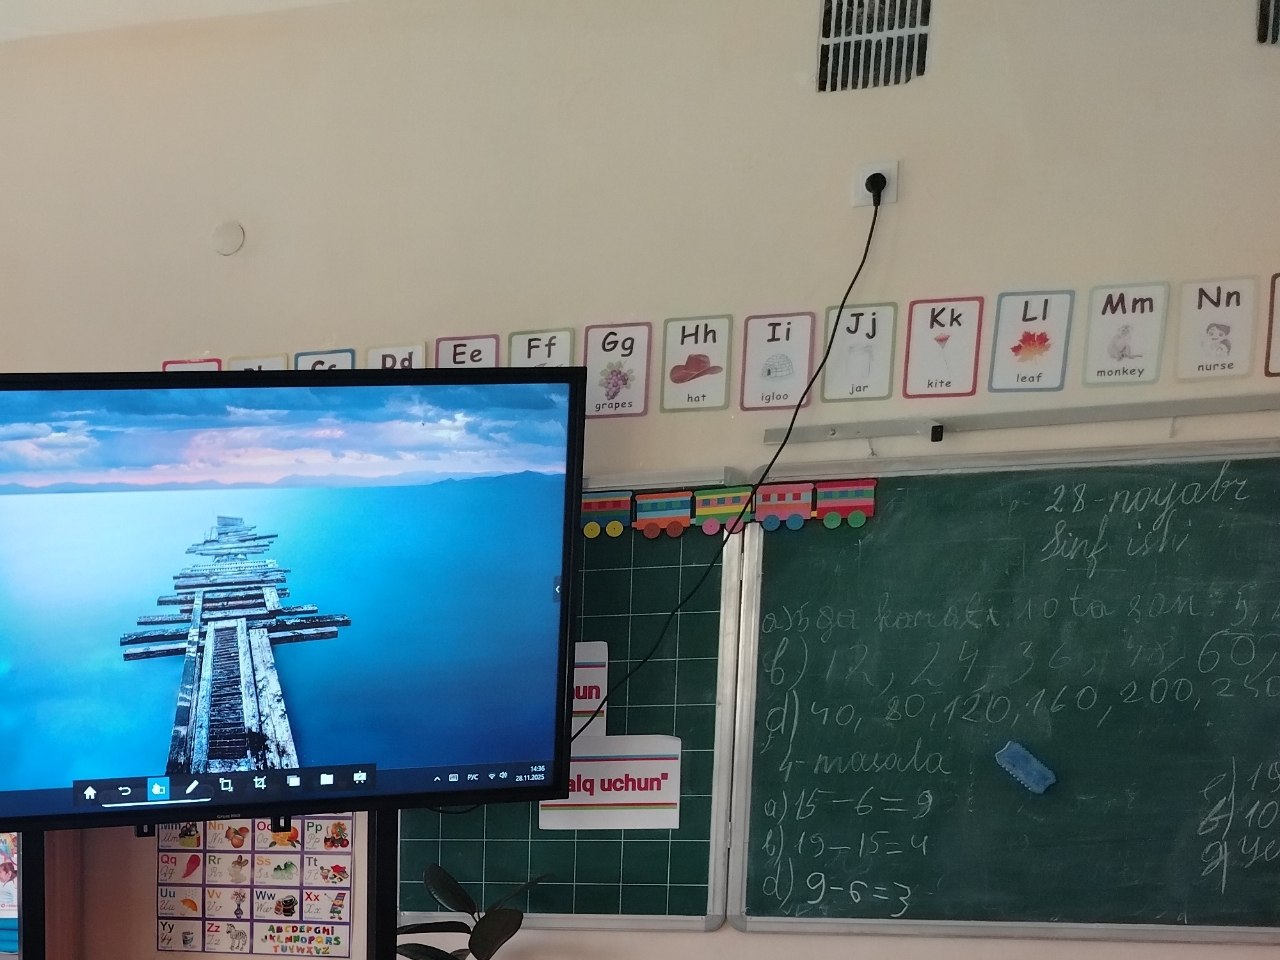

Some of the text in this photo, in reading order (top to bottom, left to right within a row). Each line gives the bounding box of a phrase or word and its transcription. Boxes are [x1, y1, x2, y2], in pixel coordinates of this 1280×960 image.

[1197, 286, 1241, 309] Nn
[1101, 292, 1153, 315] Mm
[1021, 298, 1048, 322] Ll
[929, 307, 962, 329] Kk
[846, 312, 877, 339] Jj
[681, 323, 717, 345] Hh
[767, 322, 791, 342] Ii
[527, 336, 557, 358] Ff
[601, 332, 635, 357] Gg
[452, 344, 483, 364] Ee
[1198, 362, 1235, 371] nurse
[1016, 372, 1043, 383] leaf
[1096, 367, 1145, 378] monkey
[849, 384, 869, 395] jar
[927, 379, 951, 389] kite
[687, 394, 706, 402] hat
[761, 393, 789, 404] igloo
[595, 401, 633, 411] grapes
[515, 773, 545, 782] 28.11.2025
[208, 821, 224, 830] Nn
[306, 821, 322, 833] Pp
[160, 854, 177, 866] Qq
[208, 854, 222, 864] Rr
[256, 856, 271, 866] Ss
[306, 856, 318, 867] Tt
[160, 888, 176, 898] Uu
[207, 889, 222, 899] Vv
[255, 890, 276, 901] Ww
[305, 891, 320, 901] Xx
[160, 921, 175, 933] Yy
[207, 922, 221, 932] Zz
